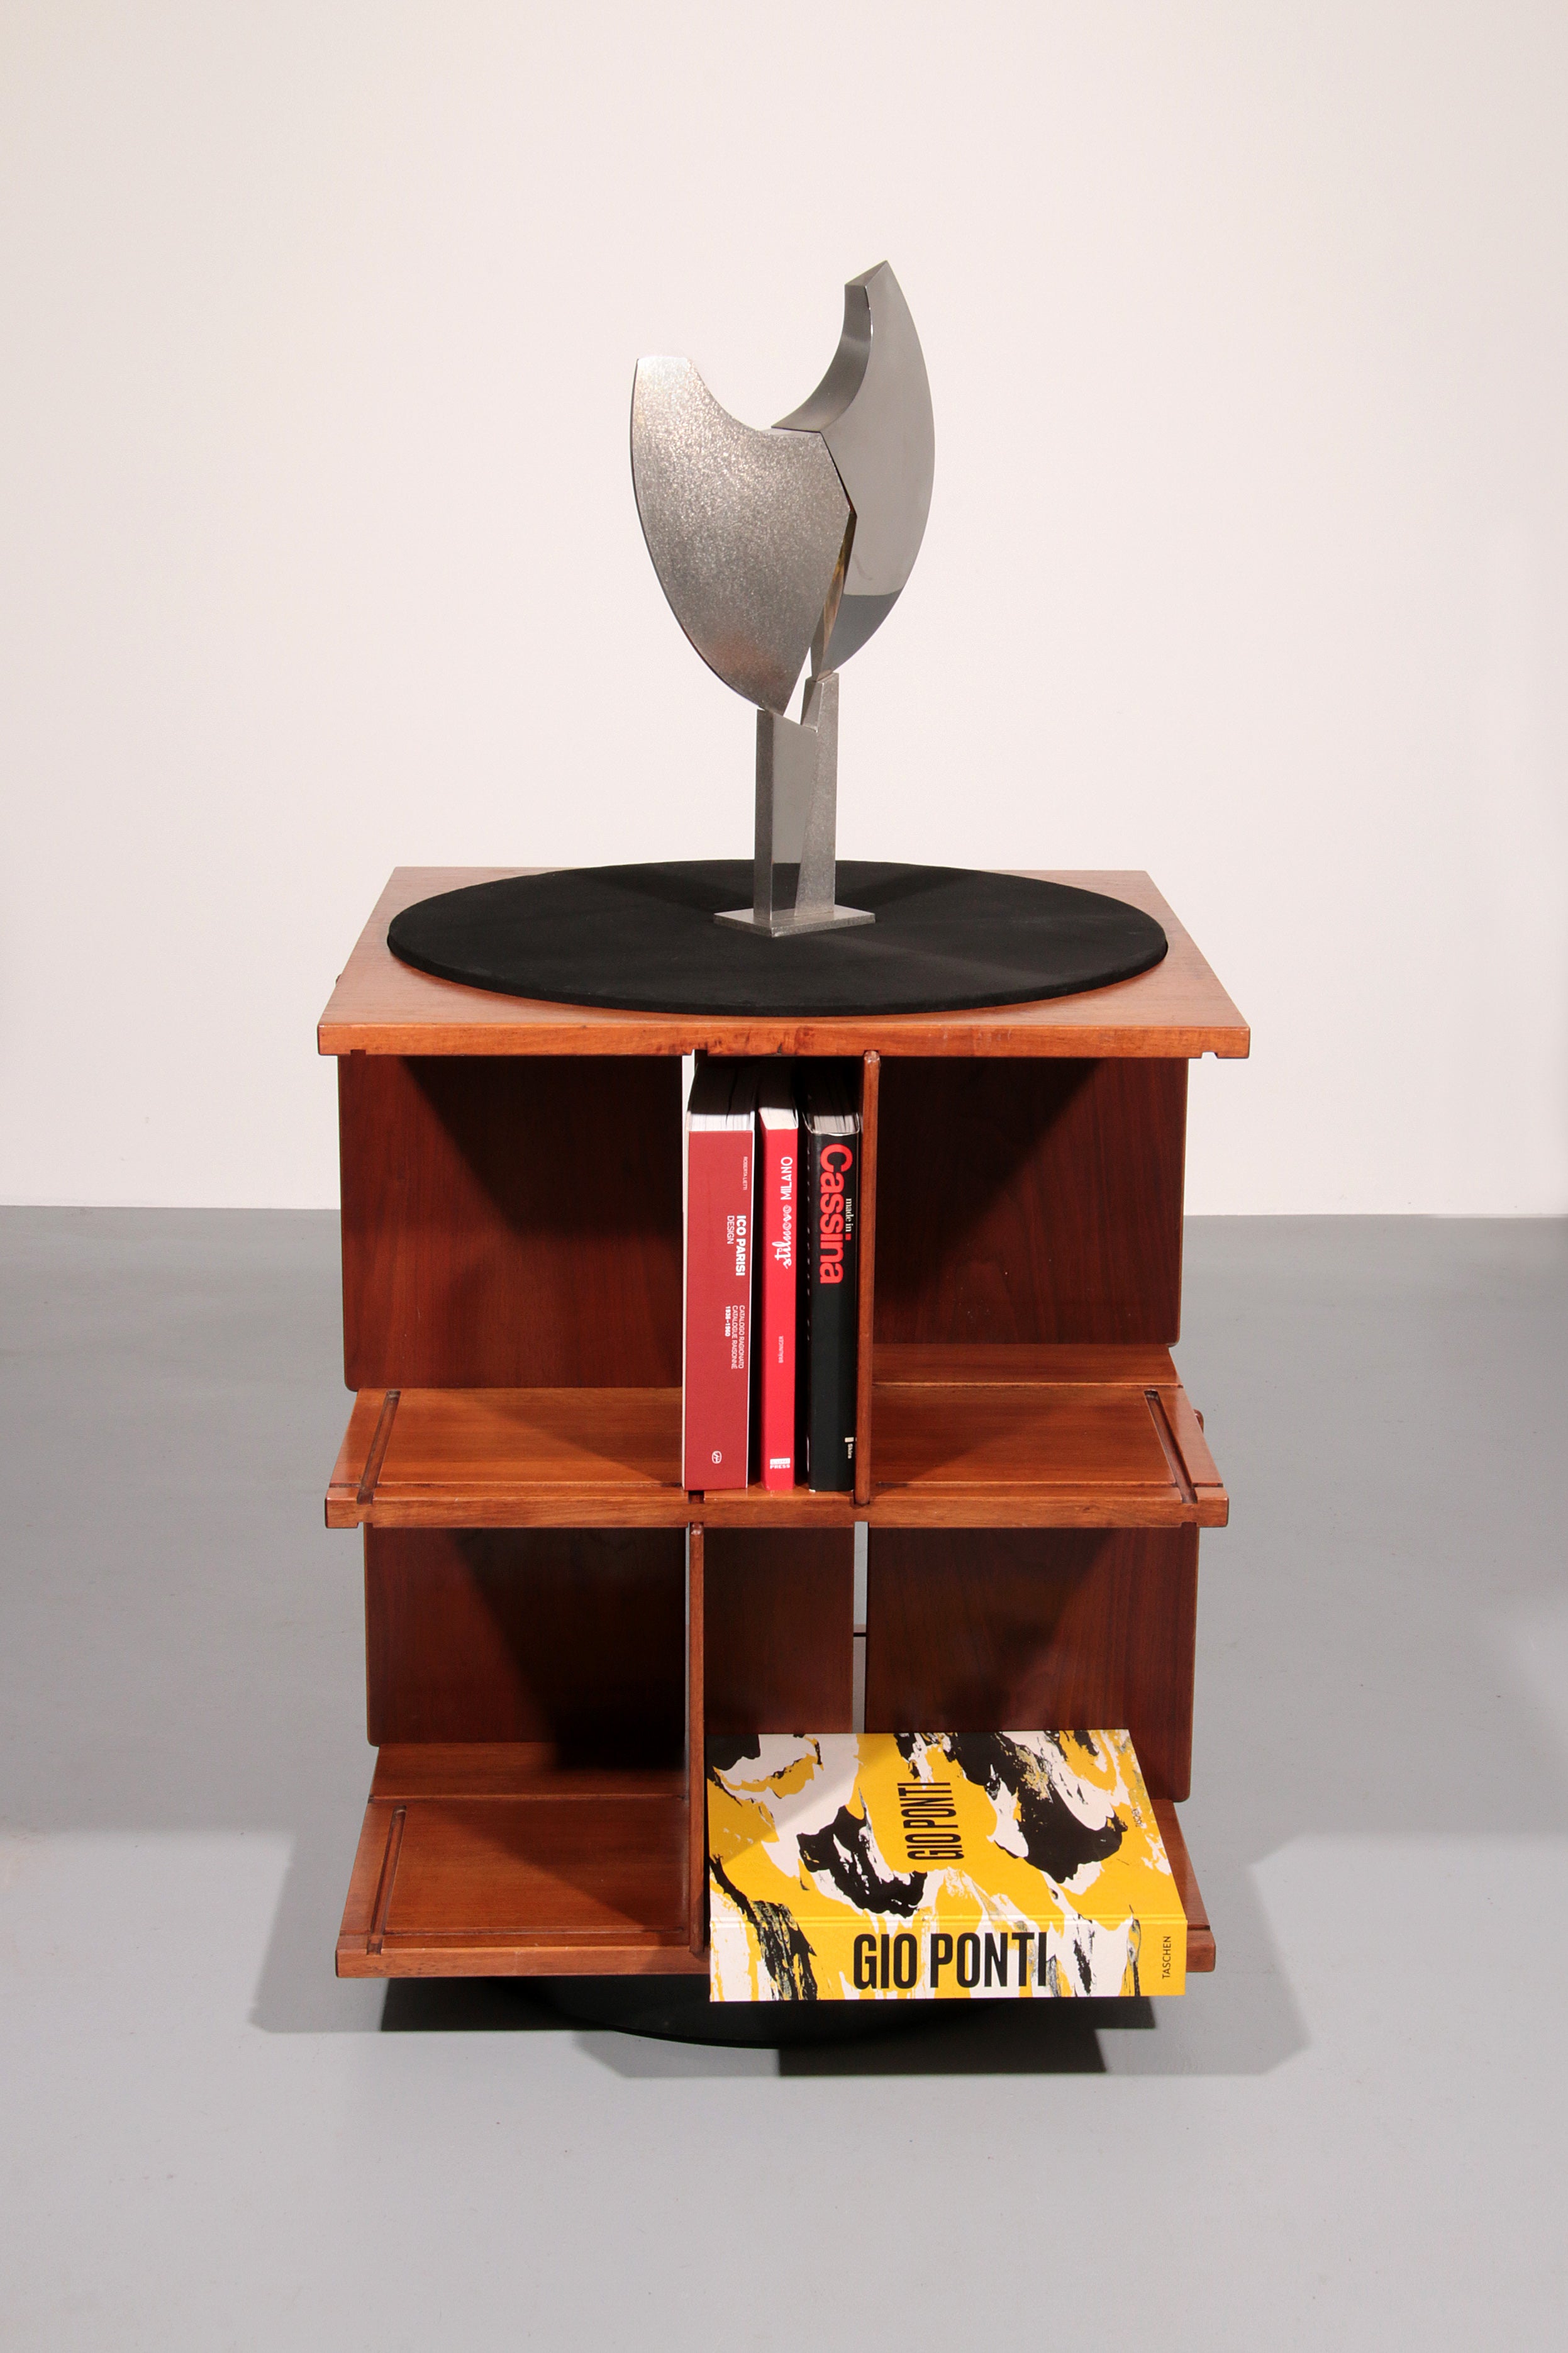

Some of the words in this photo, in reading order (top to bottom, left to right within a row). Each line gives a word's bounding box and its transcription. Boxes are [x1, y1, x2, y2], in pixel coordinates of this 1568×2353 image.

[781, 1156, 793, 1200] MILANO
[726, 1215, 735, 1244] DESIGN
[737, 1215, 747, 1236] ICO
[820, 1144, 853, 1283] Cassina
[845, 1198, 854, 1222] made
[845, 1223, 854, 1232] in
[772, 1204, 792, 1269] stilnovo
[735, 1239, 746, 1276] PARISI
[897, 1782, 959, 1828] PONTI
[904, 1833, 965, 1860] GIO
[854, 1933, 917, 1990] GIO
[930, 1932, 1047, 1988] PONTI
[1162, 1936, 1171, 1979] TASCHEN
